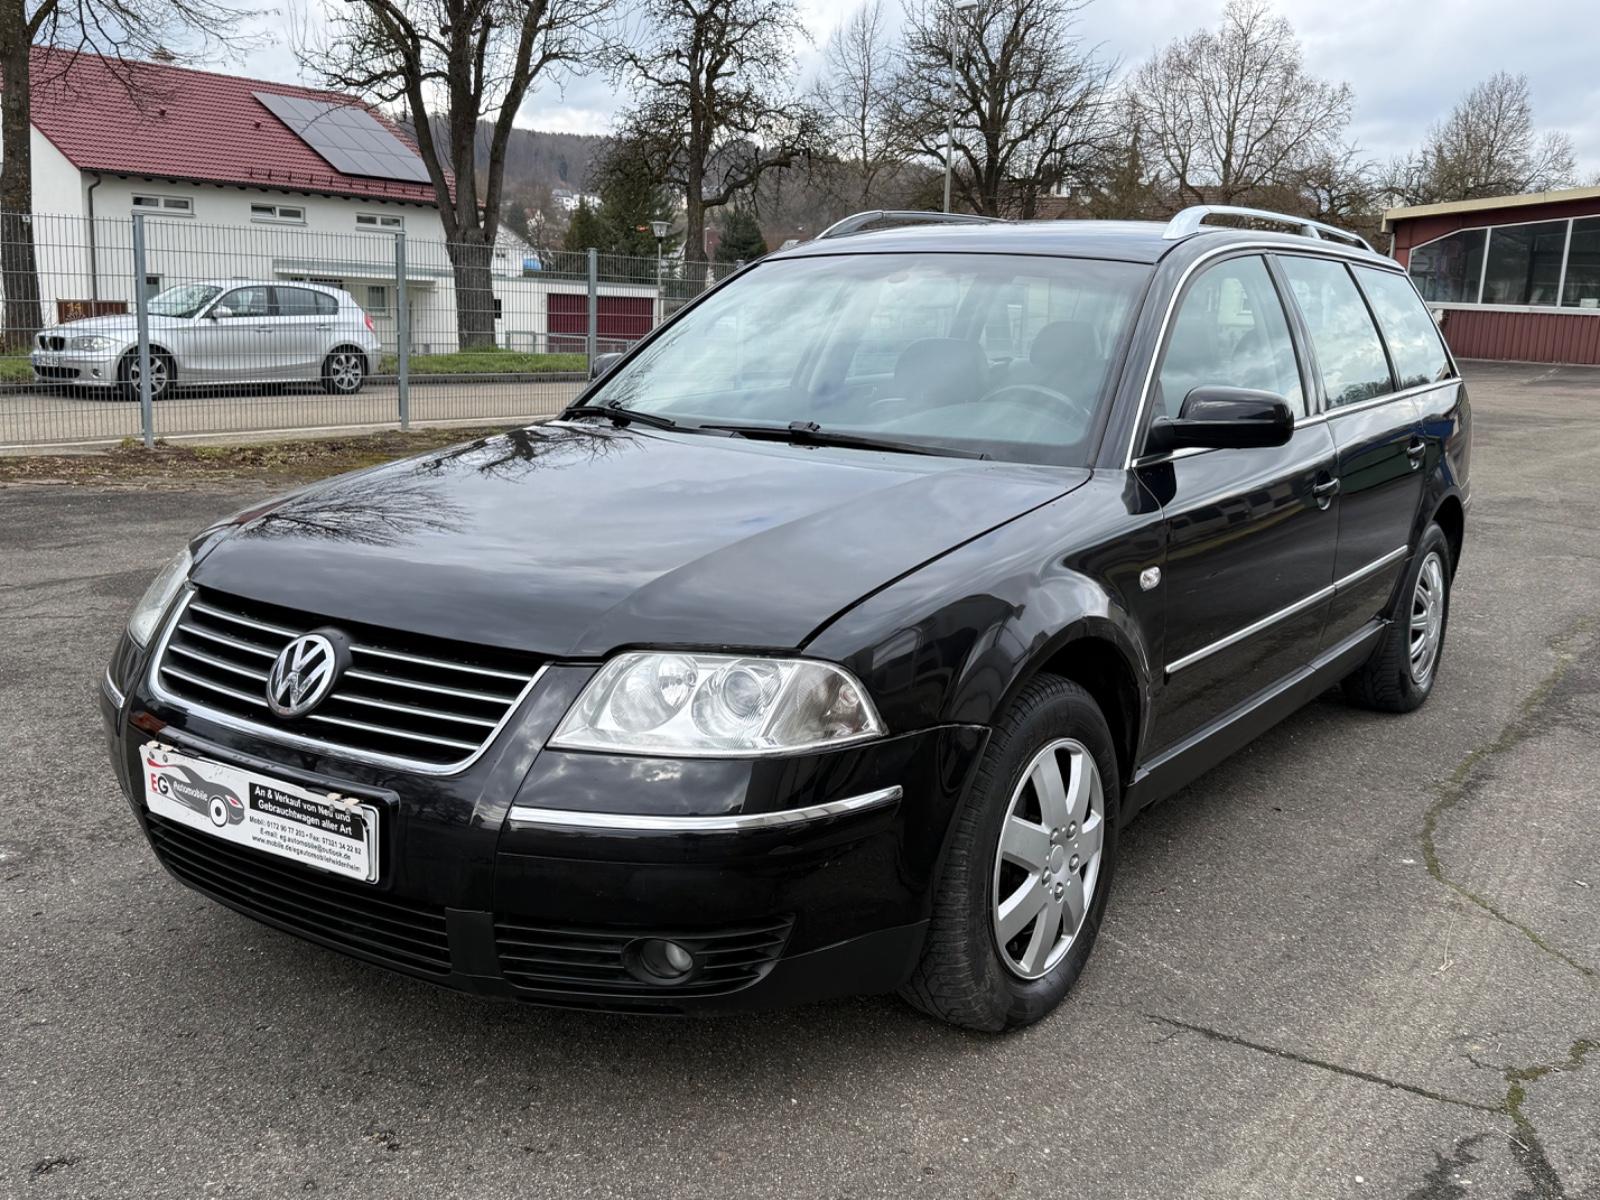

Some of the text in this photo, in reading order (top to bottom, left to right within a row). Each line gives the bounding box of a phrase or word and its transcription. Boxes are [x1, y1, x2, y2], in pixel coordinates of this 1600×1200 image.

[268, 634, 335, 715] VW
[150, 772, 208, 801] EG Automobile
[254, 786, 351, 823] An & Verkauf von Neu und
[258, 799, 353, 835] Gebrauchtwagen aller Art
[266, 821, 280, 831] 0172
